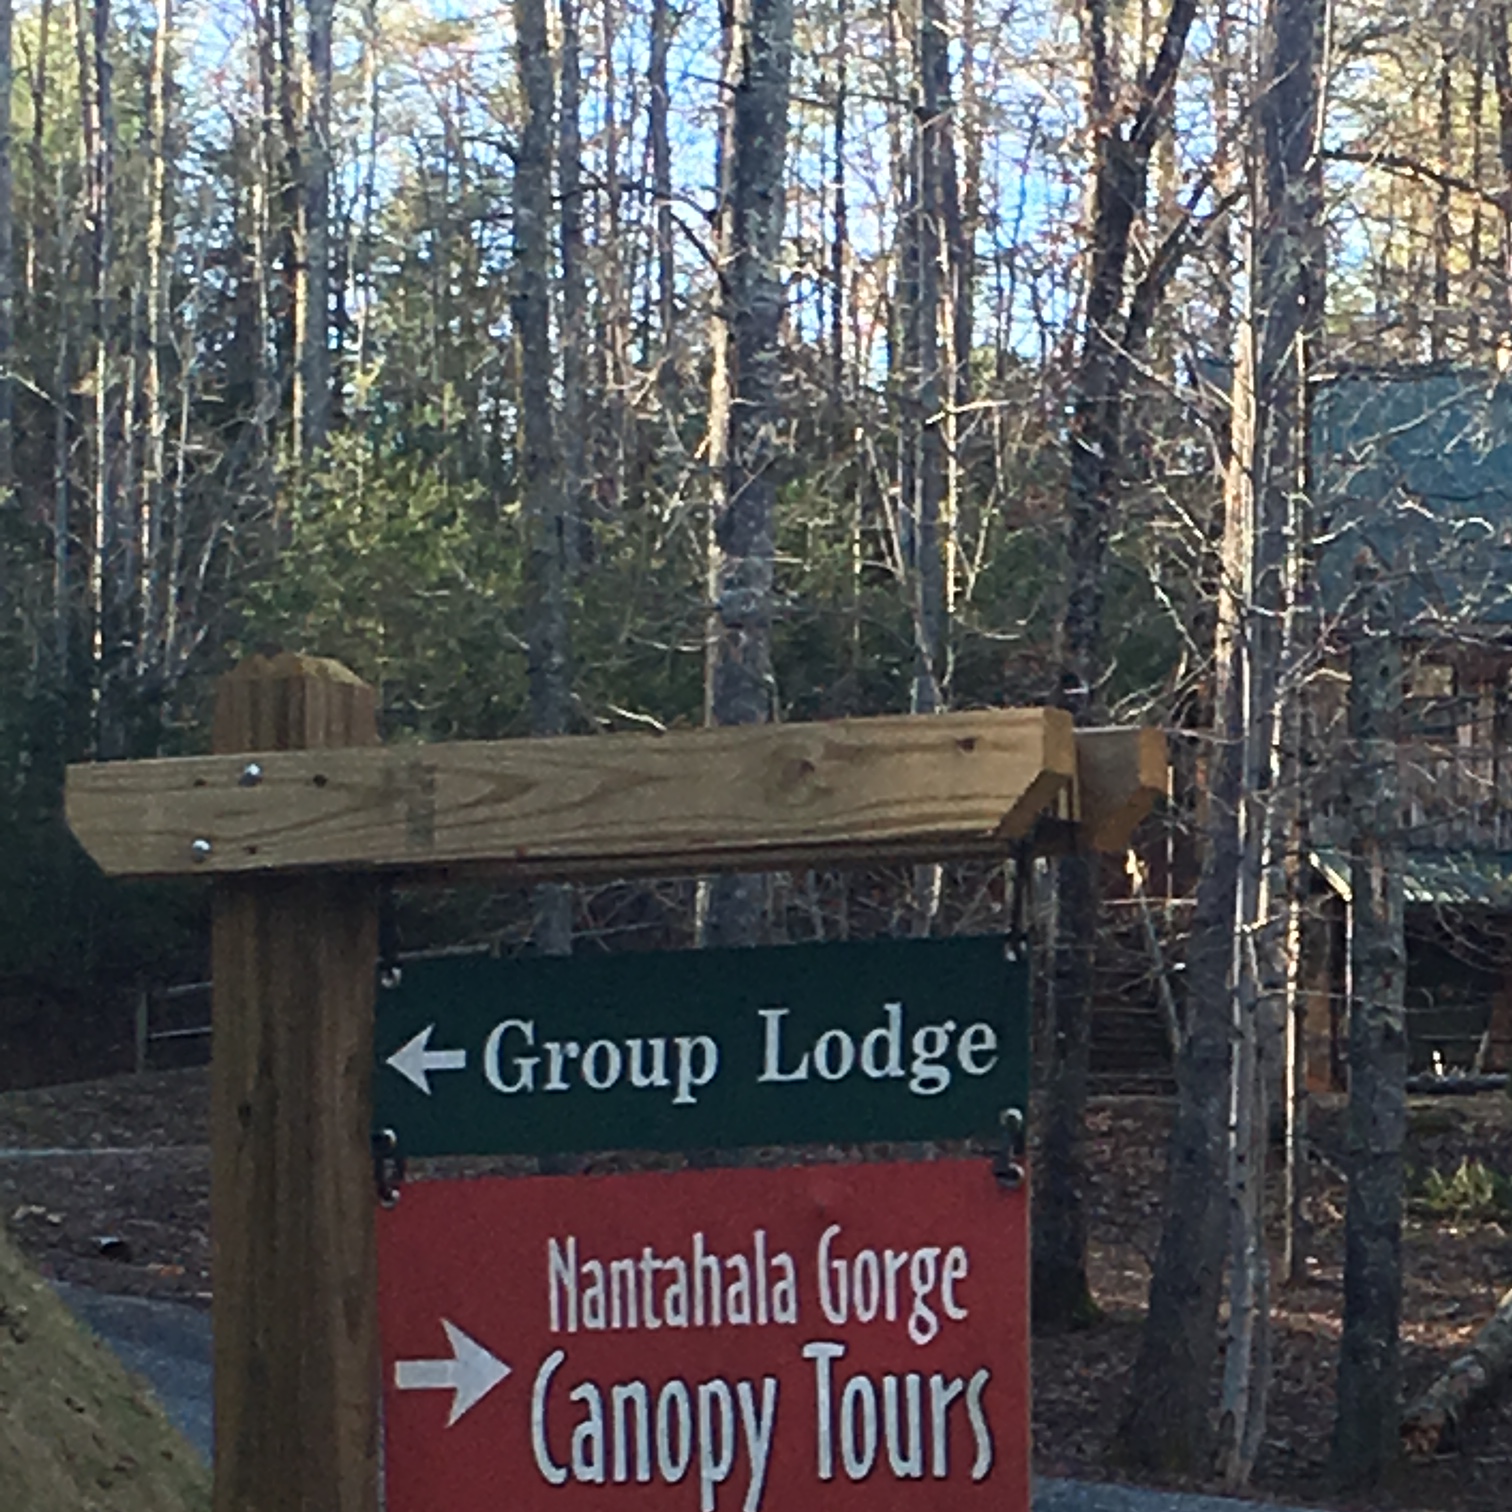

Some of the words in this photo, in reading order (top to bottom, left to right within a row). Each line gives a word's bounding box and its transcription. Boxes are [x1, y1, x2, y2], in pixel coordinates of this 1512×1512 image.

[482, 1017, 719, 1105] Group
[757, 1002, 999, 1096] Lodge
[546, 1228, 798, 1334] Nantahala
[816, 1223, 970, 1347] Gorge
[801, 1341, 993, 1481] Tours
